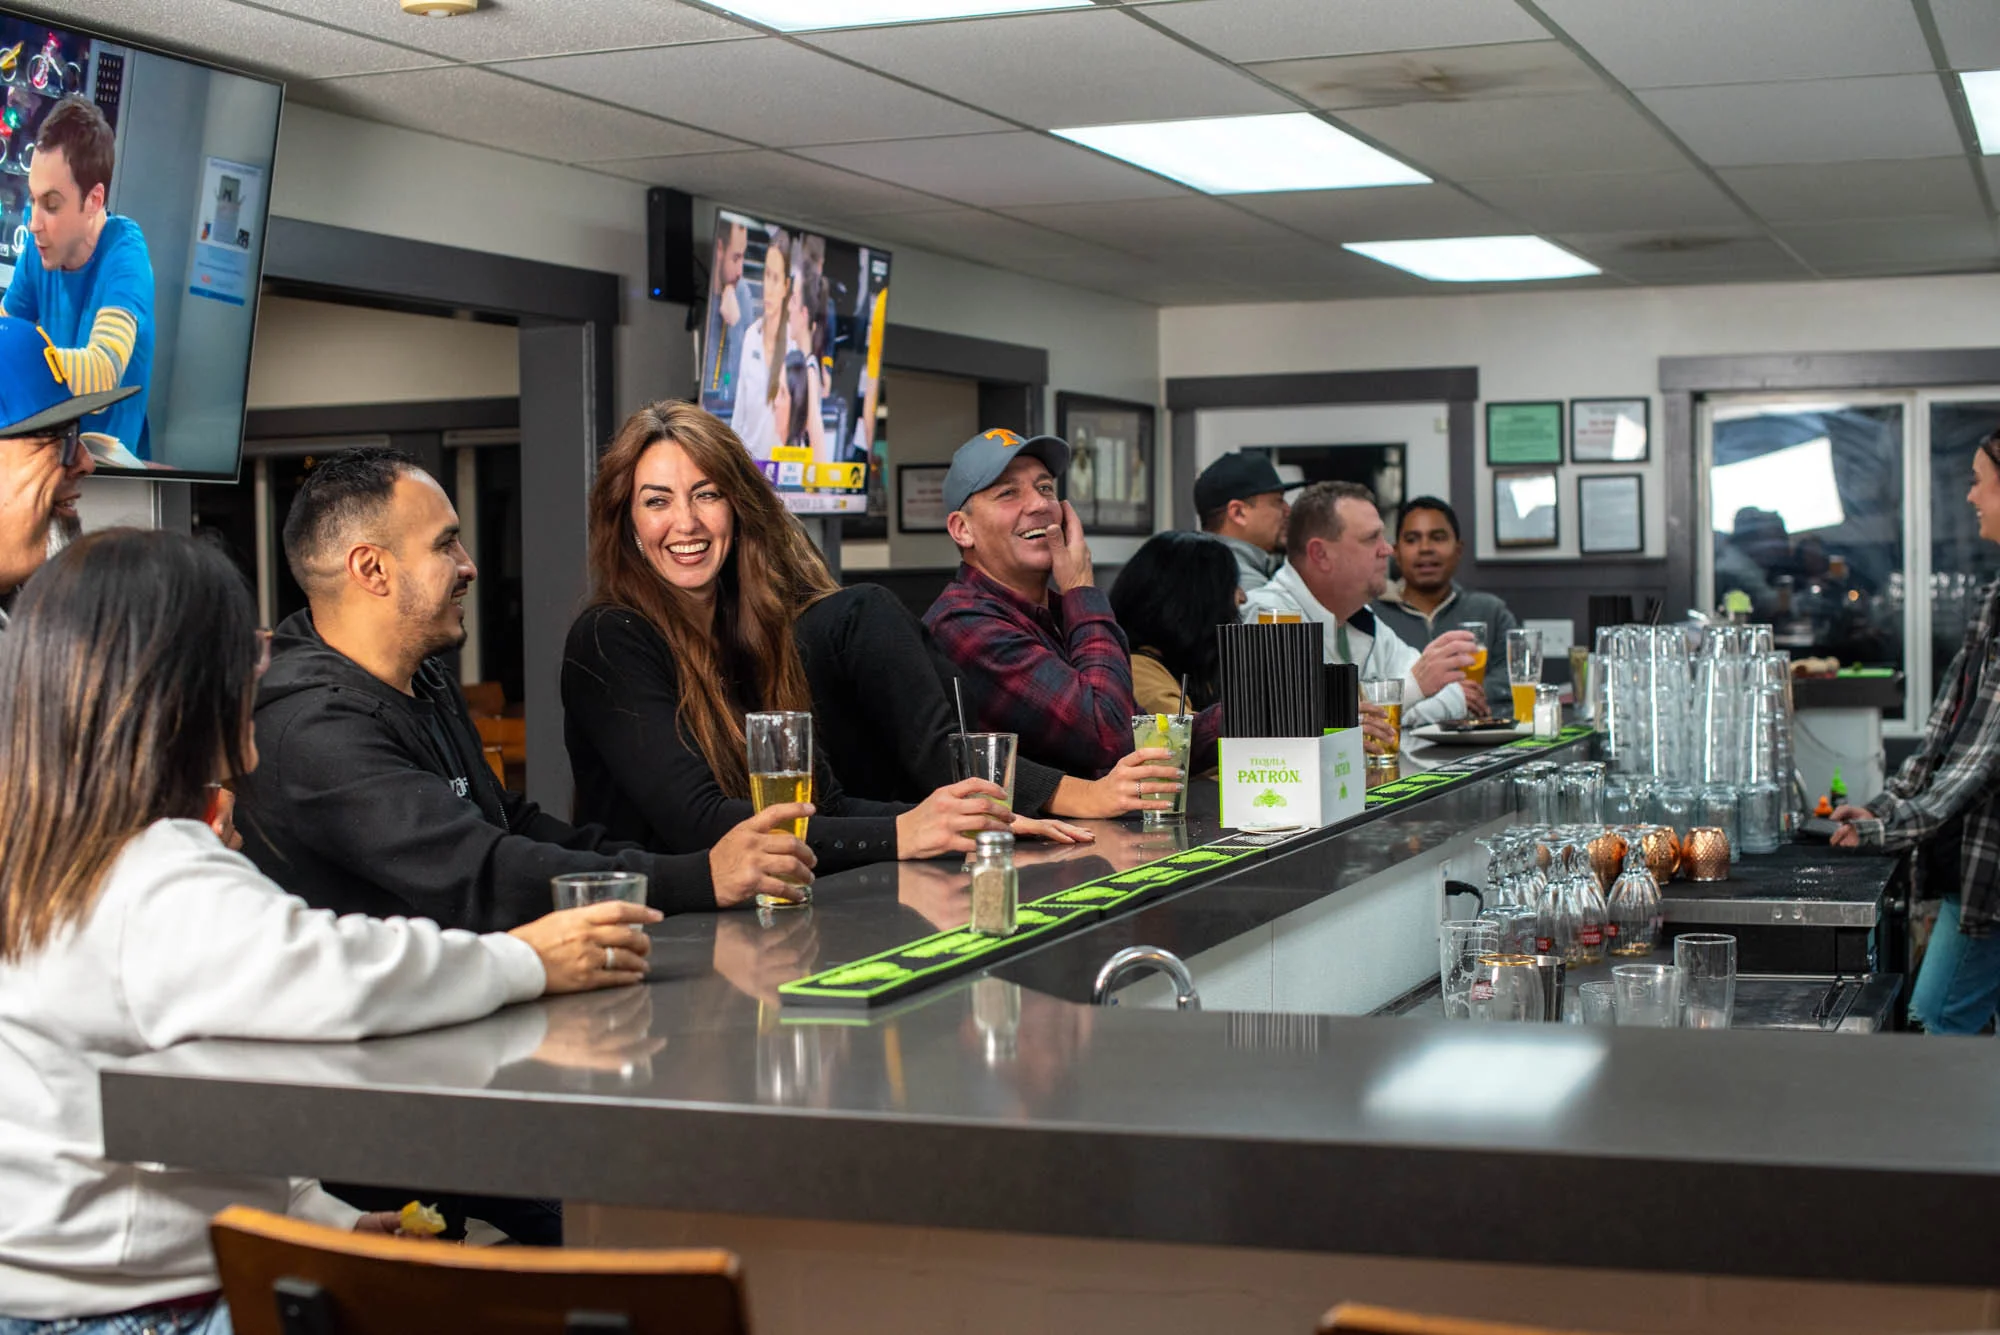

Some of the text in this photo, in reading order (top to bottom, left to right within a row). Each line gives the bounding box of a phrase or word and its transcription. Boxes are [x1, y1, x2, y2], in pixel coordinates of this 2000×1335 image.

[984, 428, 1020, 447] T
[1249, 757, 1287, 767] TEQUILA
[1237, 767, 1300, 784] PATRÓN
